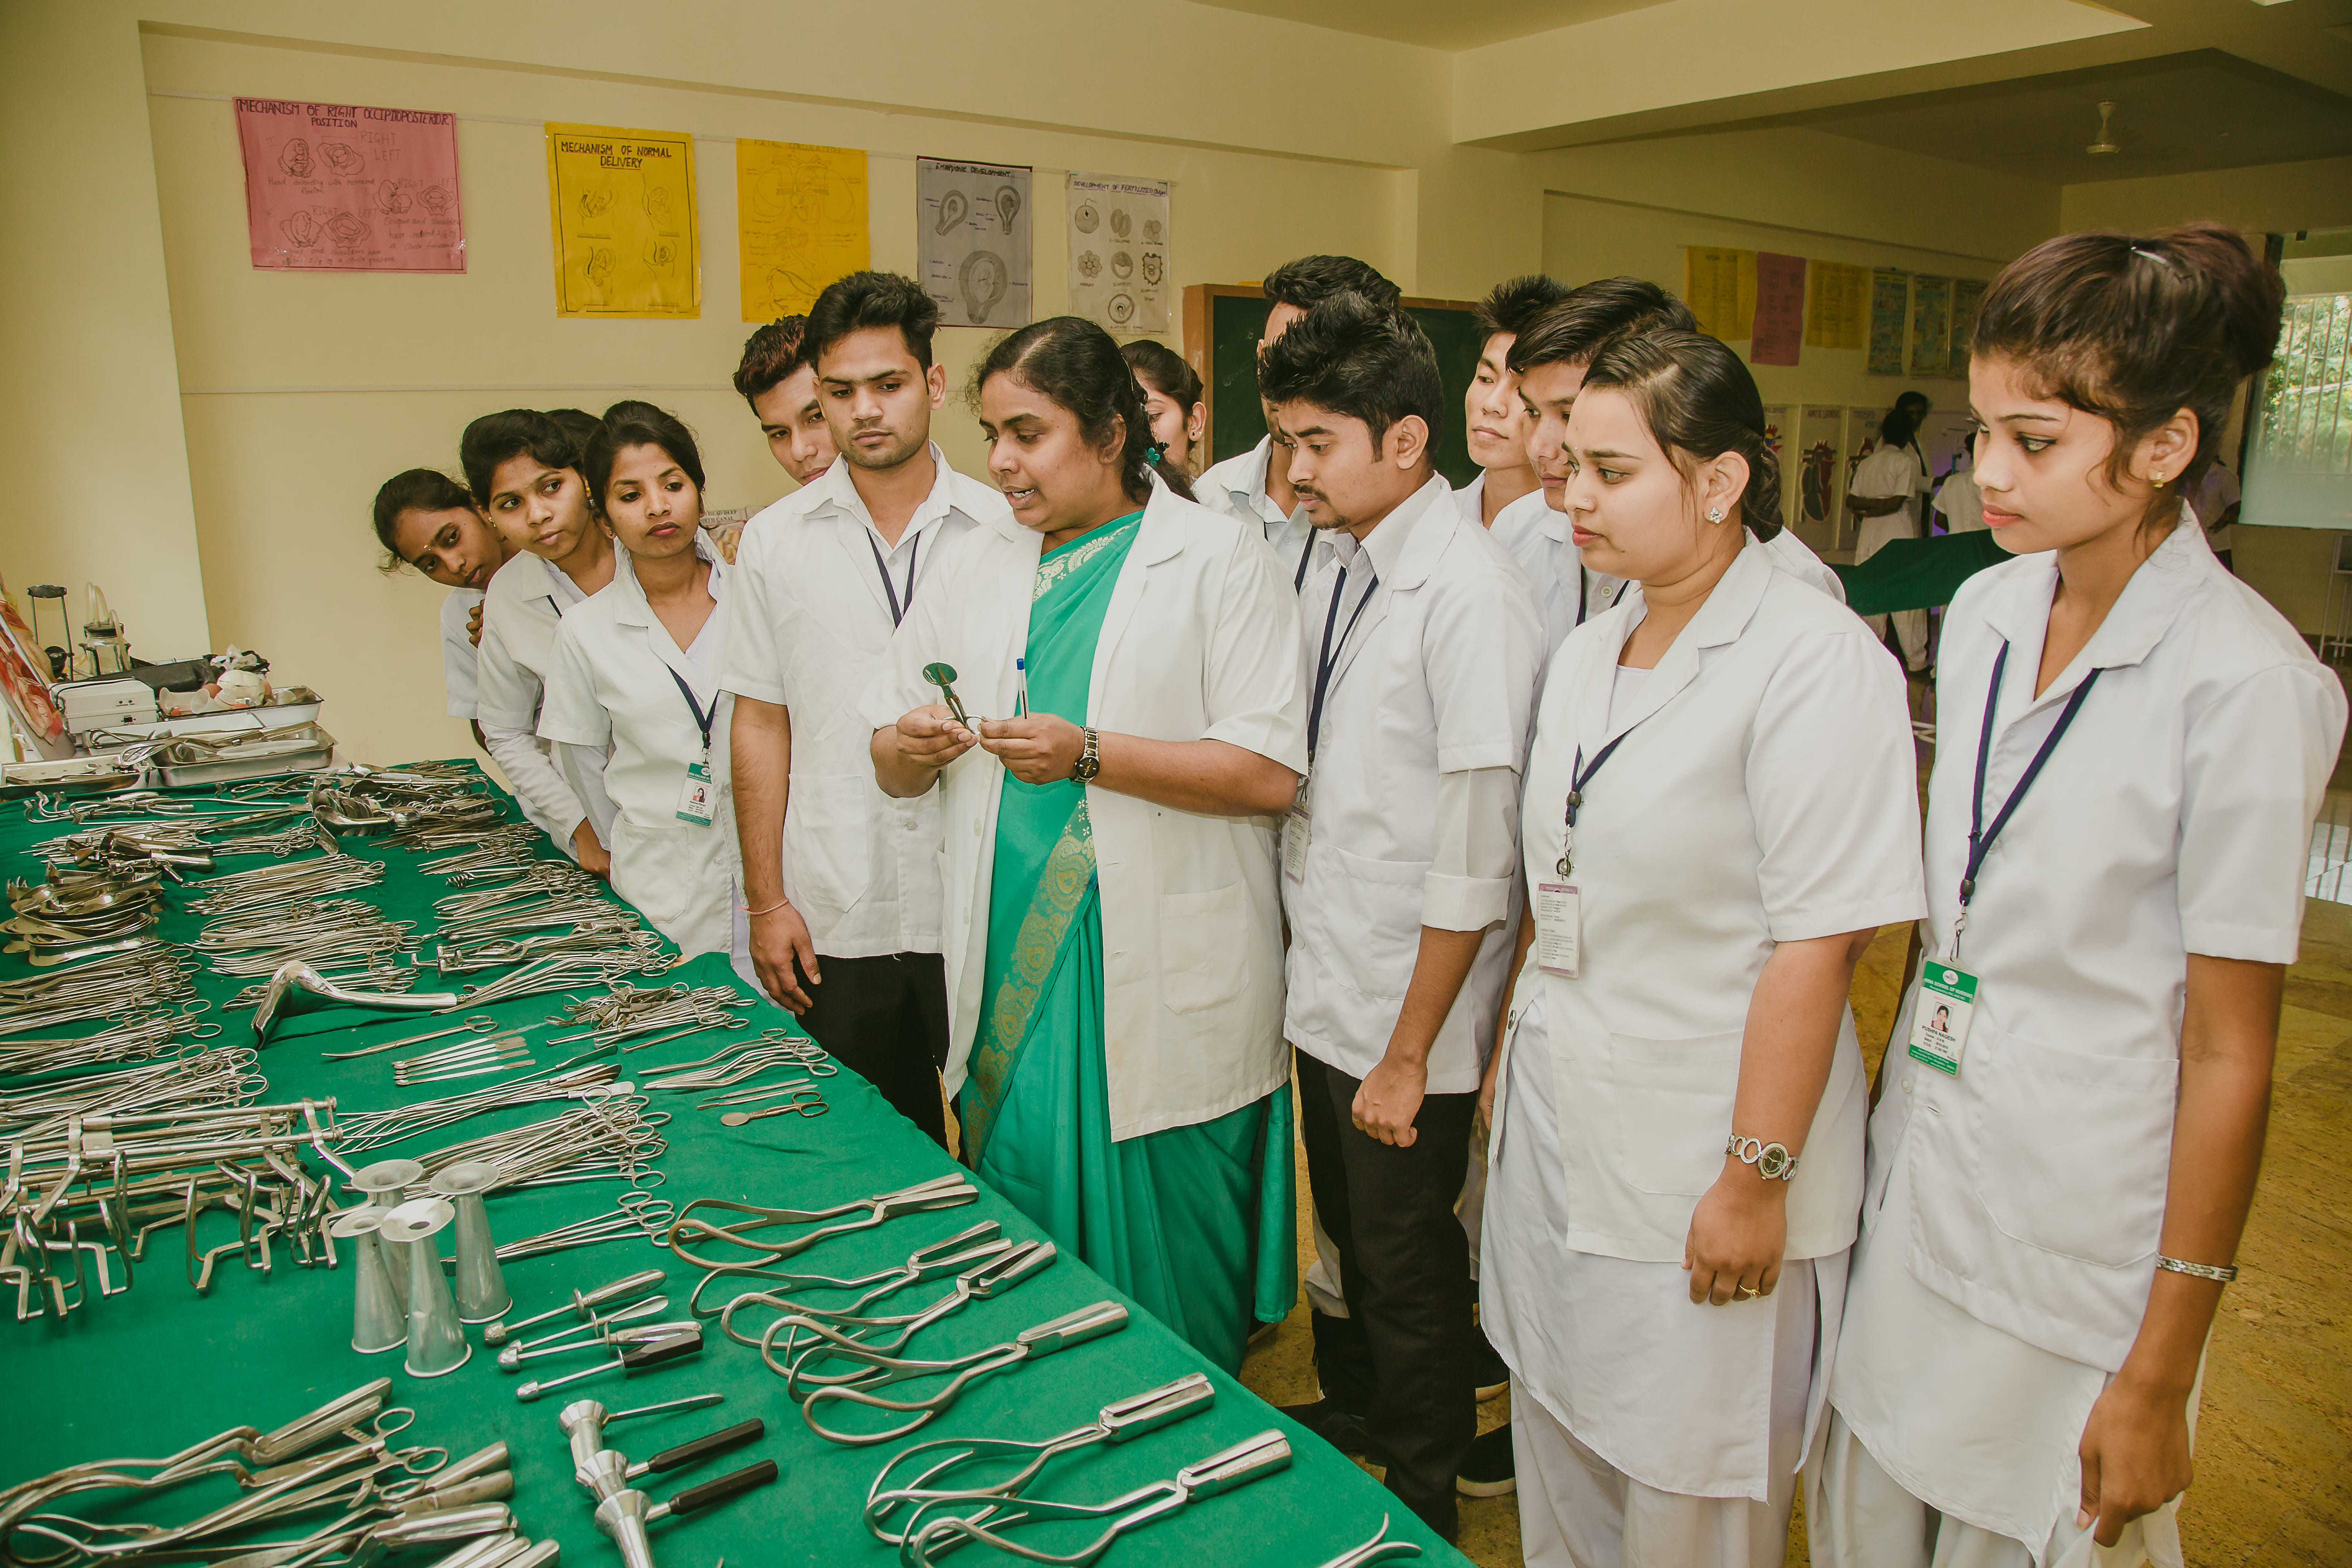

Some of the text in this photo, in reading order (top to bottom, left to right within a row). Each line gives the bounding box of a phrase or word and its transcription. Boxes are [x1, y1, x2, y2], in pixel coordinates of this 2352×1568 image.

[238, 100, 301, 115] MECHANISM
[307, 105, 321, 116] OF
[328, 106, 358, 118] RIGHT
[311, 117, 357, 128] POSITION
[359, 131, 397, 145] RIGHT
[374, 149, 401, 162] LEFT
[561, 141, 672, 158] MECHANISM OF NORMAL
[600, 156, 642, 168] DELIVERY
[970, 167, 1011, 178] DEVELOPMENT
[398, 178, 425, 188] RIGHT
[1074, 181, 1109, 190] DEVELOPMENT
[311, 205, 339, 217] RIGHT
[1922, 1025, 1956, 1042] PUSHPA NAGESH
